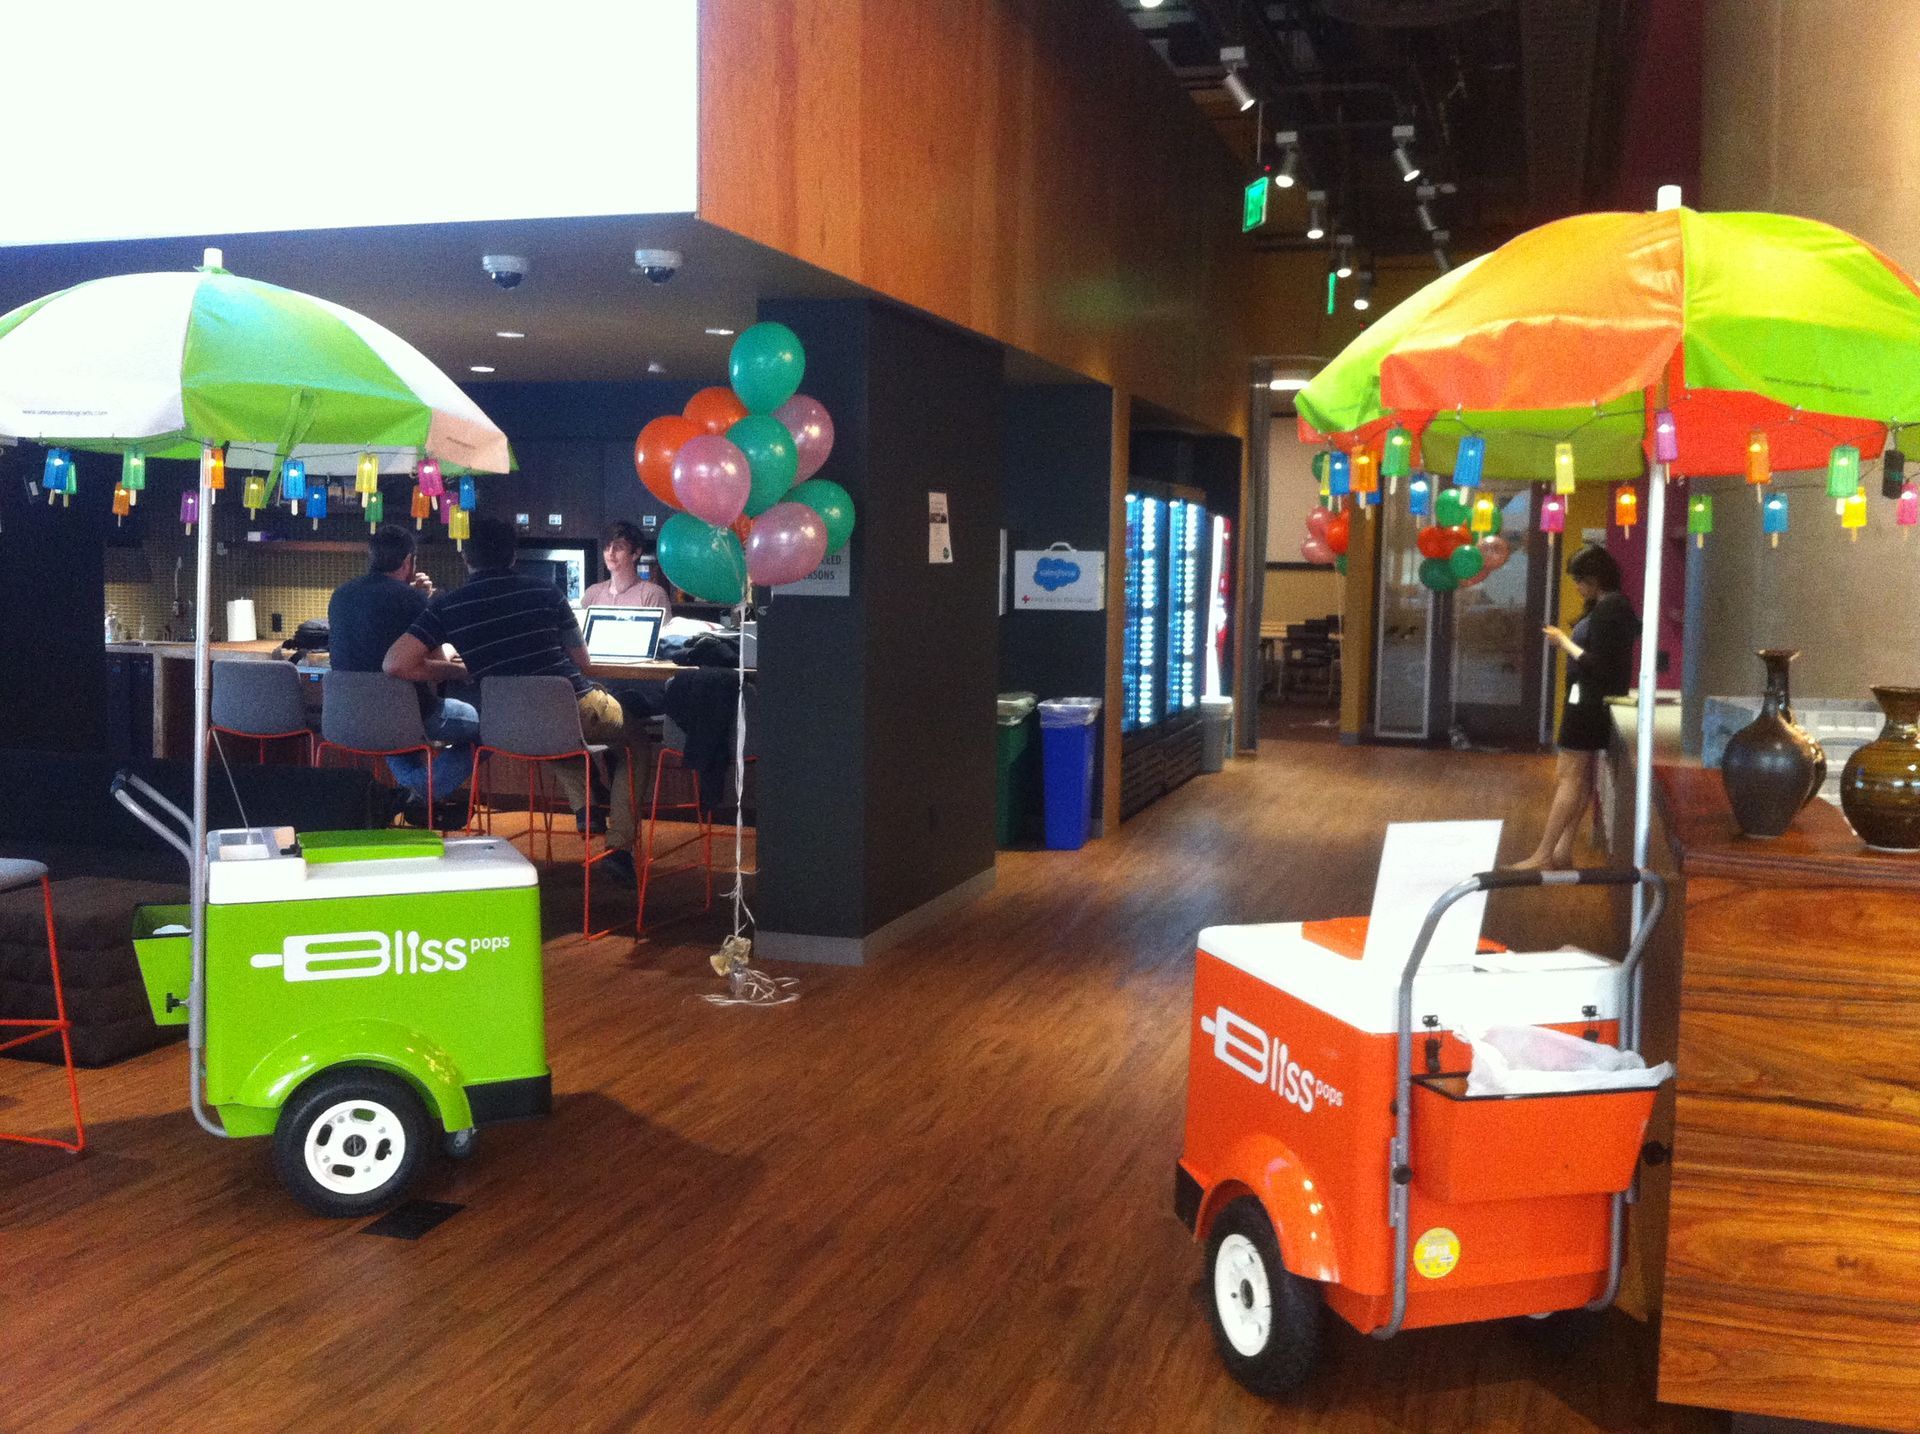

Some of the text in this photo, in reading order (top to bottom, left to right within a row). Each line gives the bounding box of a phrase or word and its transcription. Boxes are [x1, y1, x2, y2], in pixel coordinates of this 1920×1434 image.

[821, 555, 841, 565] EED
[283, 930, 510, 982] Bliss pops
[1214, 1005, 1343, 1113] Bliss pops
